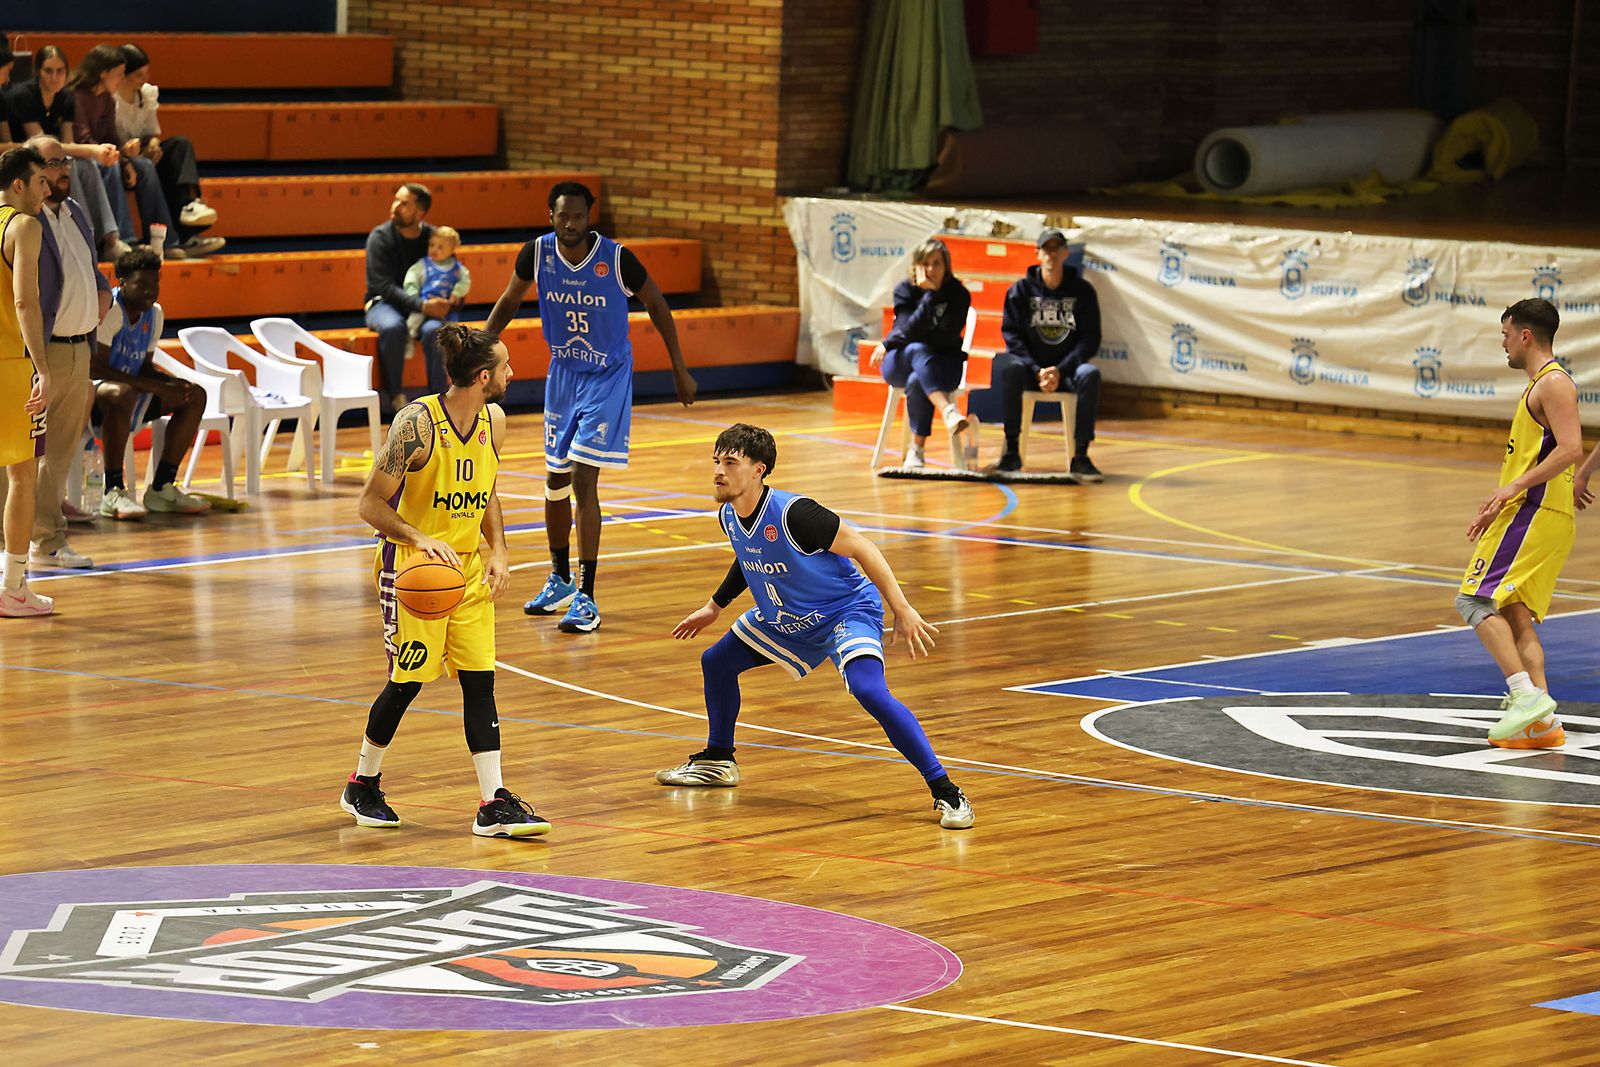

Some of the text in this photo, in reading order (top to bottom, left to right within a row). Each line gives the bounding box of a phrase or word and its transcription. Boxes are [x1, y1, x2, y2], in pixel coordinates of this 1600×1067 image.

[859, 245, 905, 257] HUELVA
[1189, 273, 1237, 288] HUELVA
[565, 310, 589, 334] 35
[1200, 357, 1249, 372] HUELVA
[1320, 371, 1370, 385] HUELVA
[1446, 381, 1496, 396] HUELVA
[455, 458, 474, 482] 10
[433, 490, 488, 511] HOMS
[1472, 557, 1486, 576] 9
[398, 639, 426, 671] hp
[648, 984, 687, 992] DE
